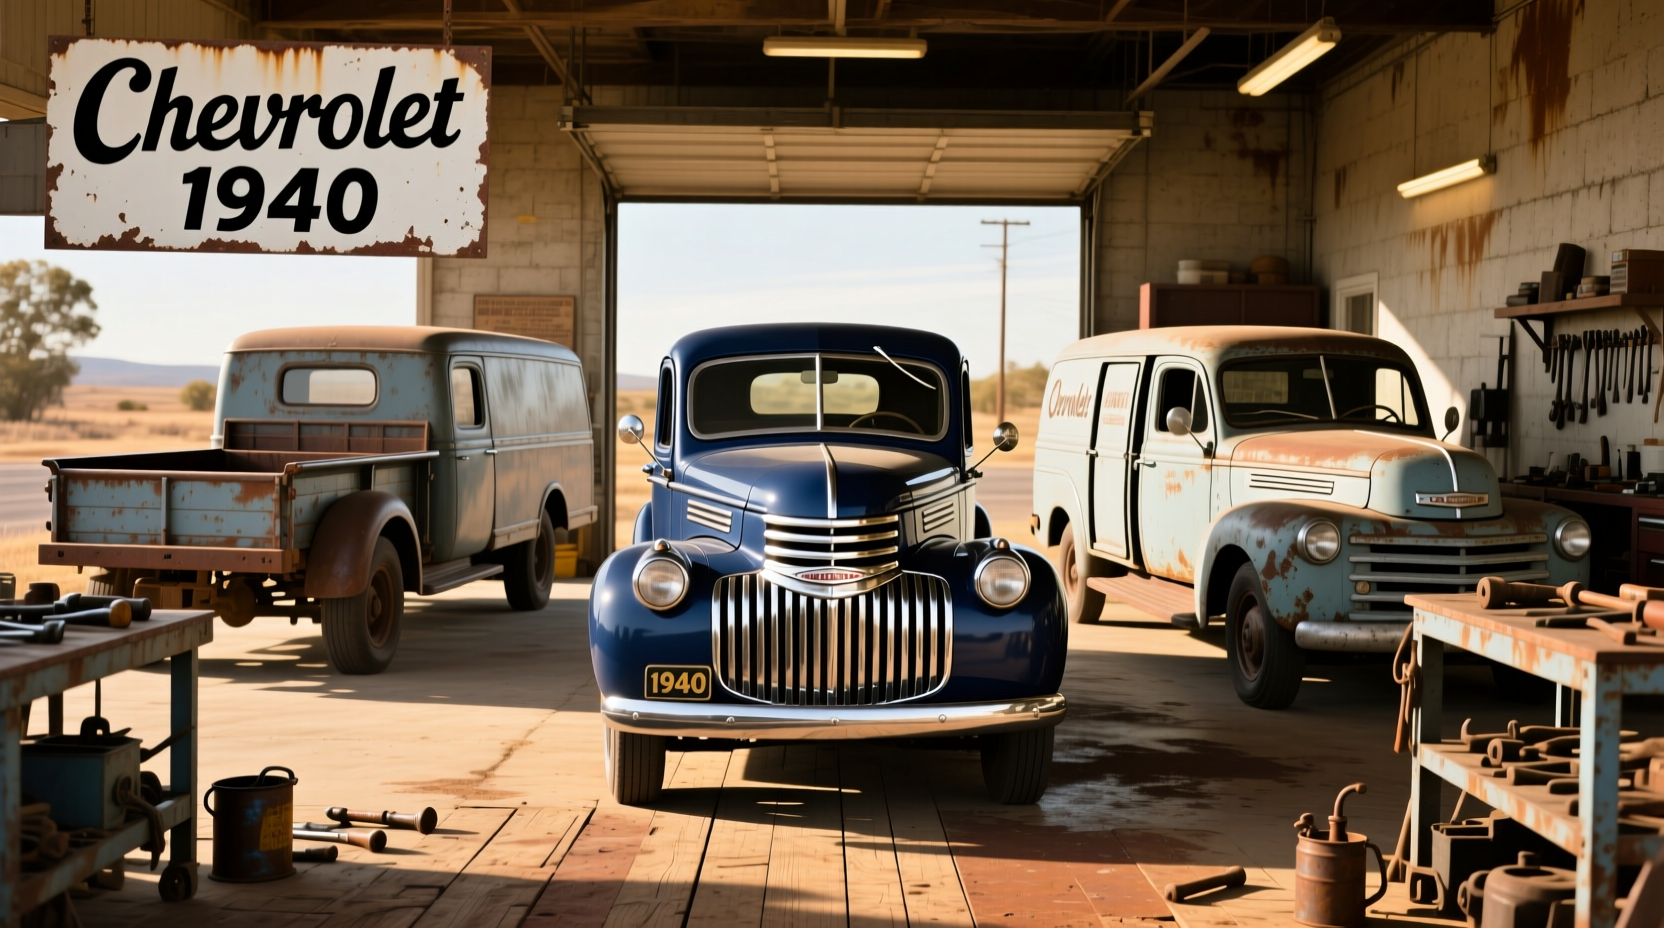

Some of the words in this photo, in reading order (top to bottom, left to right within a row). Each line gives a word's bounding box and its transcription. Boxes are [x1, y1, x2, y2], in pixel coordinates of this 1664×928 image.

[73, 57, 464, 164] Chevrolet
[182, 165, 379, 235] 1940
[650, 671, 706, 694] 1940
